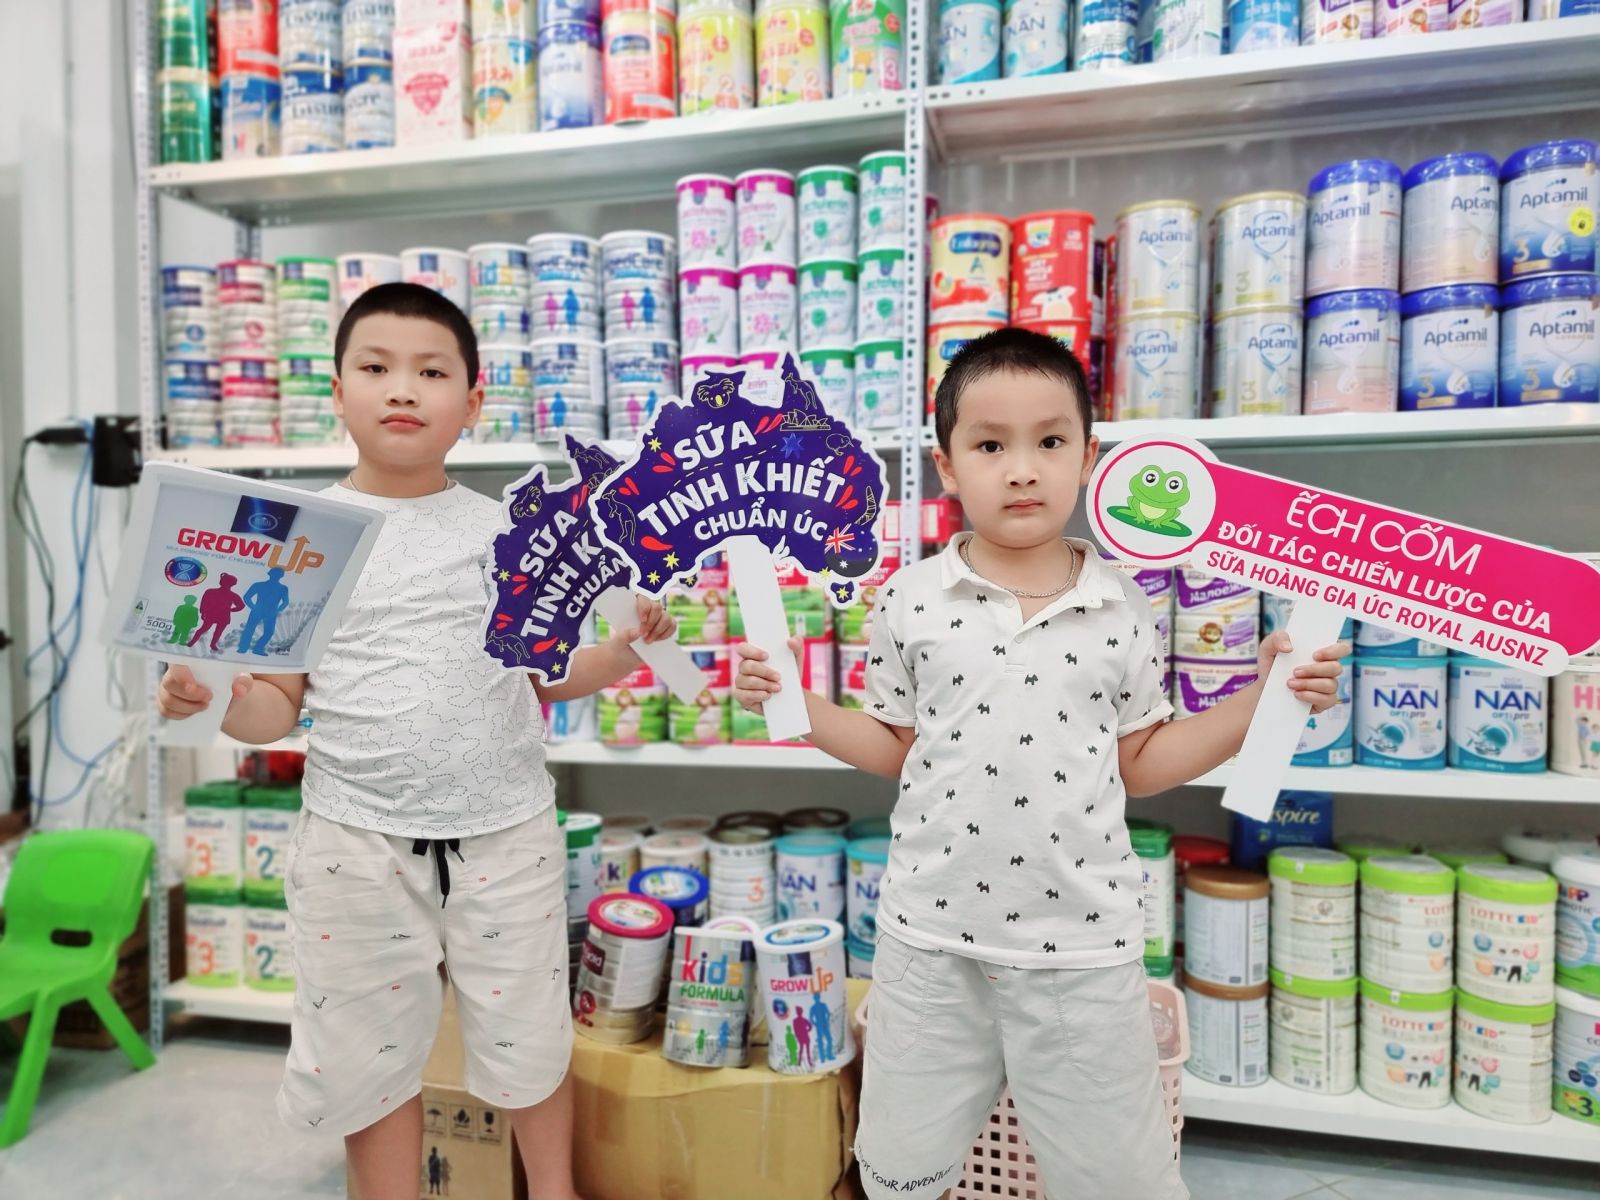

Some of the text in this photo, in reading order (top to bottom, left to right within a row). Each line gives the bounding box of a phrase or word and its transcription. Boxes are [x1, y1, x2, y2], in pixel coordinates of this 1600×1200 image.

[1520, 187, 1588, 209] Aptamil
[1311, 202, 1371, 226] Aptamil
[1138, 228, 1193, 249] Aptamil
[1241, 224, 1297, 247] Aptamil
[1513, 240, 1531, 263] 3
[1235, 271, 1249, 294] 3
[1318, 329, 1380, 349] Aptamil
[1424, 328, 1488, 348] Aptamil
[1529, 320, 1595, 339] Aptamil
[1126, 340, 1178, 359] Aptamil
[1248, 335, 1299, 355] Aptamil
[1241, 381, 1257, 401] 3
[1417, 376, 1436, 398] 3
[1520, 368, 1541, 391] 3
[673, 420, 757, 471] SỮA
[637, 455, 846, 536] TINH KHIẾT
[694, 496, 828, 541] CHUẨN ÚC
[519, 509, 579, 579] SỮA
[1286, 491, 1482, 576] ẾCH CỐM
[177, 527, 325, 575] GROW UP
[1217, 521, 1551, 635] ĐỐI TÁC CHIẾN LƯỢC CỦA
[520, 561, 580, 638] TINH
[1206, 550, 1550, 667] SỮA HOÀNG GIA ÚC ROYAL AUSNZ
[146, 620, 172, 631] 500g
[1374, 688, 1439, 709] NAN
[1474, 689, 1542, 711] NAN
[1306, 716, 1318, 731] 4
[196, 844, 213, 877] 3
[256, 846, 274, 880] 2
[746, 876, 765, 902] 3
[198, 942, 214, 975] 3
[256, 946, 274, 980] 2
[681, 935, 745, 987] kids
[770, 966, 834, 994] GROW UP
[680, 984, 745, 1002] FORMULA
[1578, 1096, 1594, 1118] 3
[872, 1167, 899, 1192] YOUR
